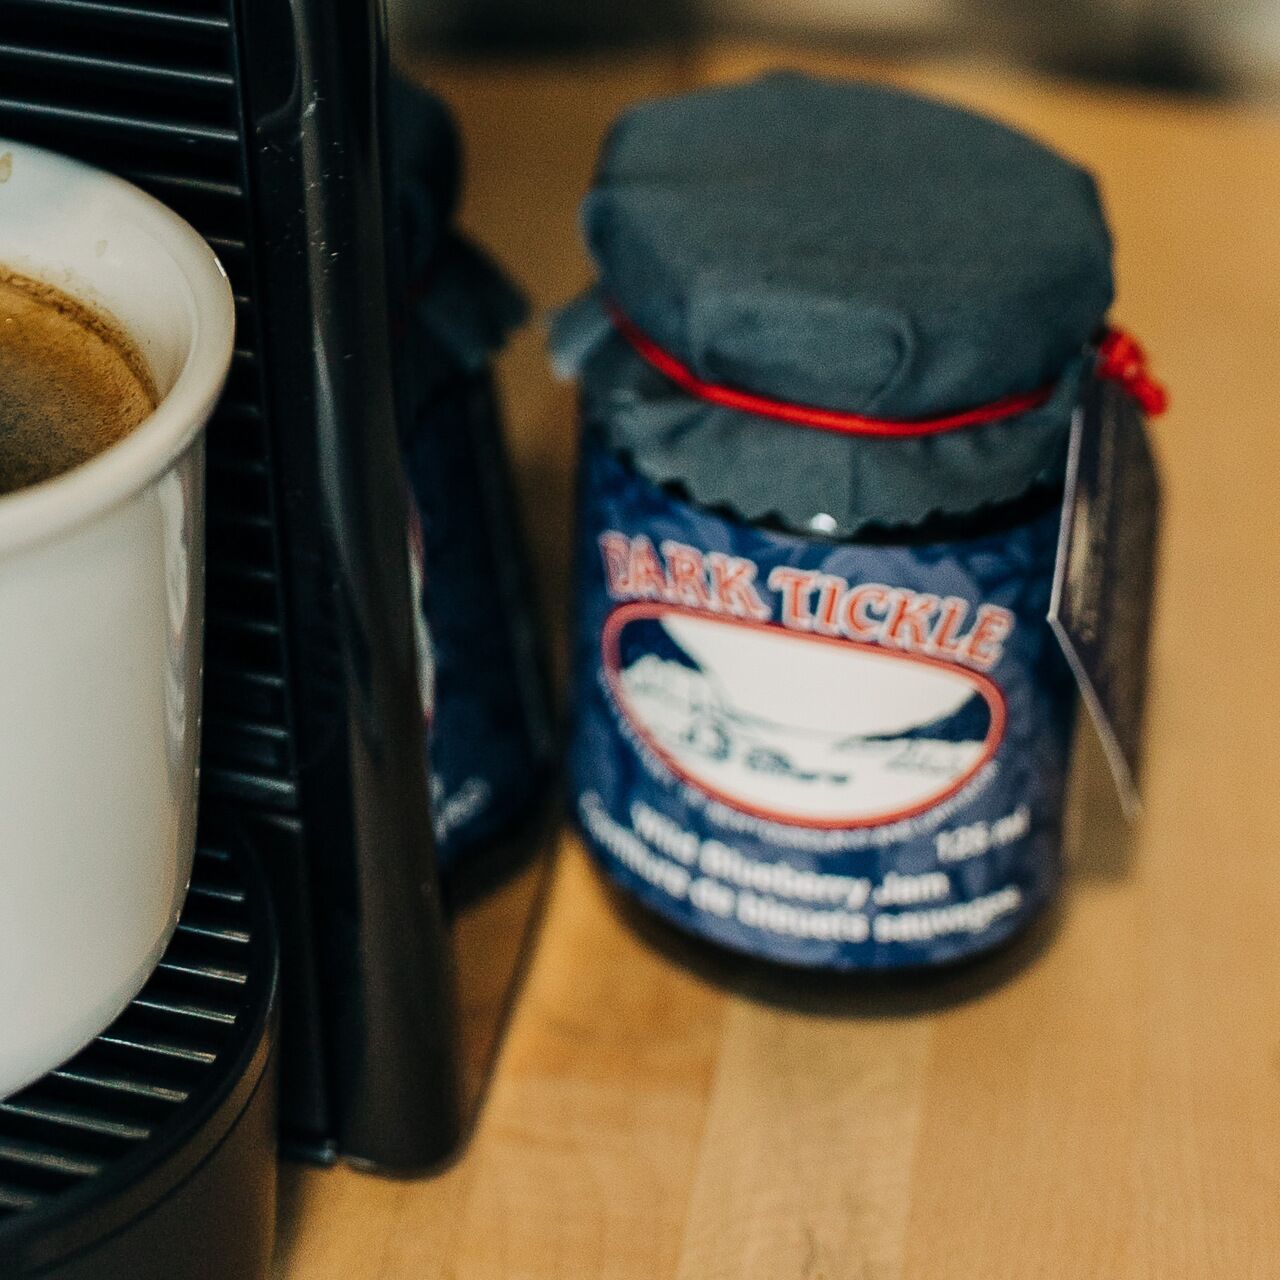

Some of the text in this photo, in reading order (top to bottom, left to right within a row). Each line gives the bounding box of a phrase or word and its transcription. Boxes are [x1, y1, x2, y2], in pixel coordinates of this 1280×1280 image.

[598, 531, 1015, 672] DARK TICKLE
[873, 871, 950, 906] Jam
